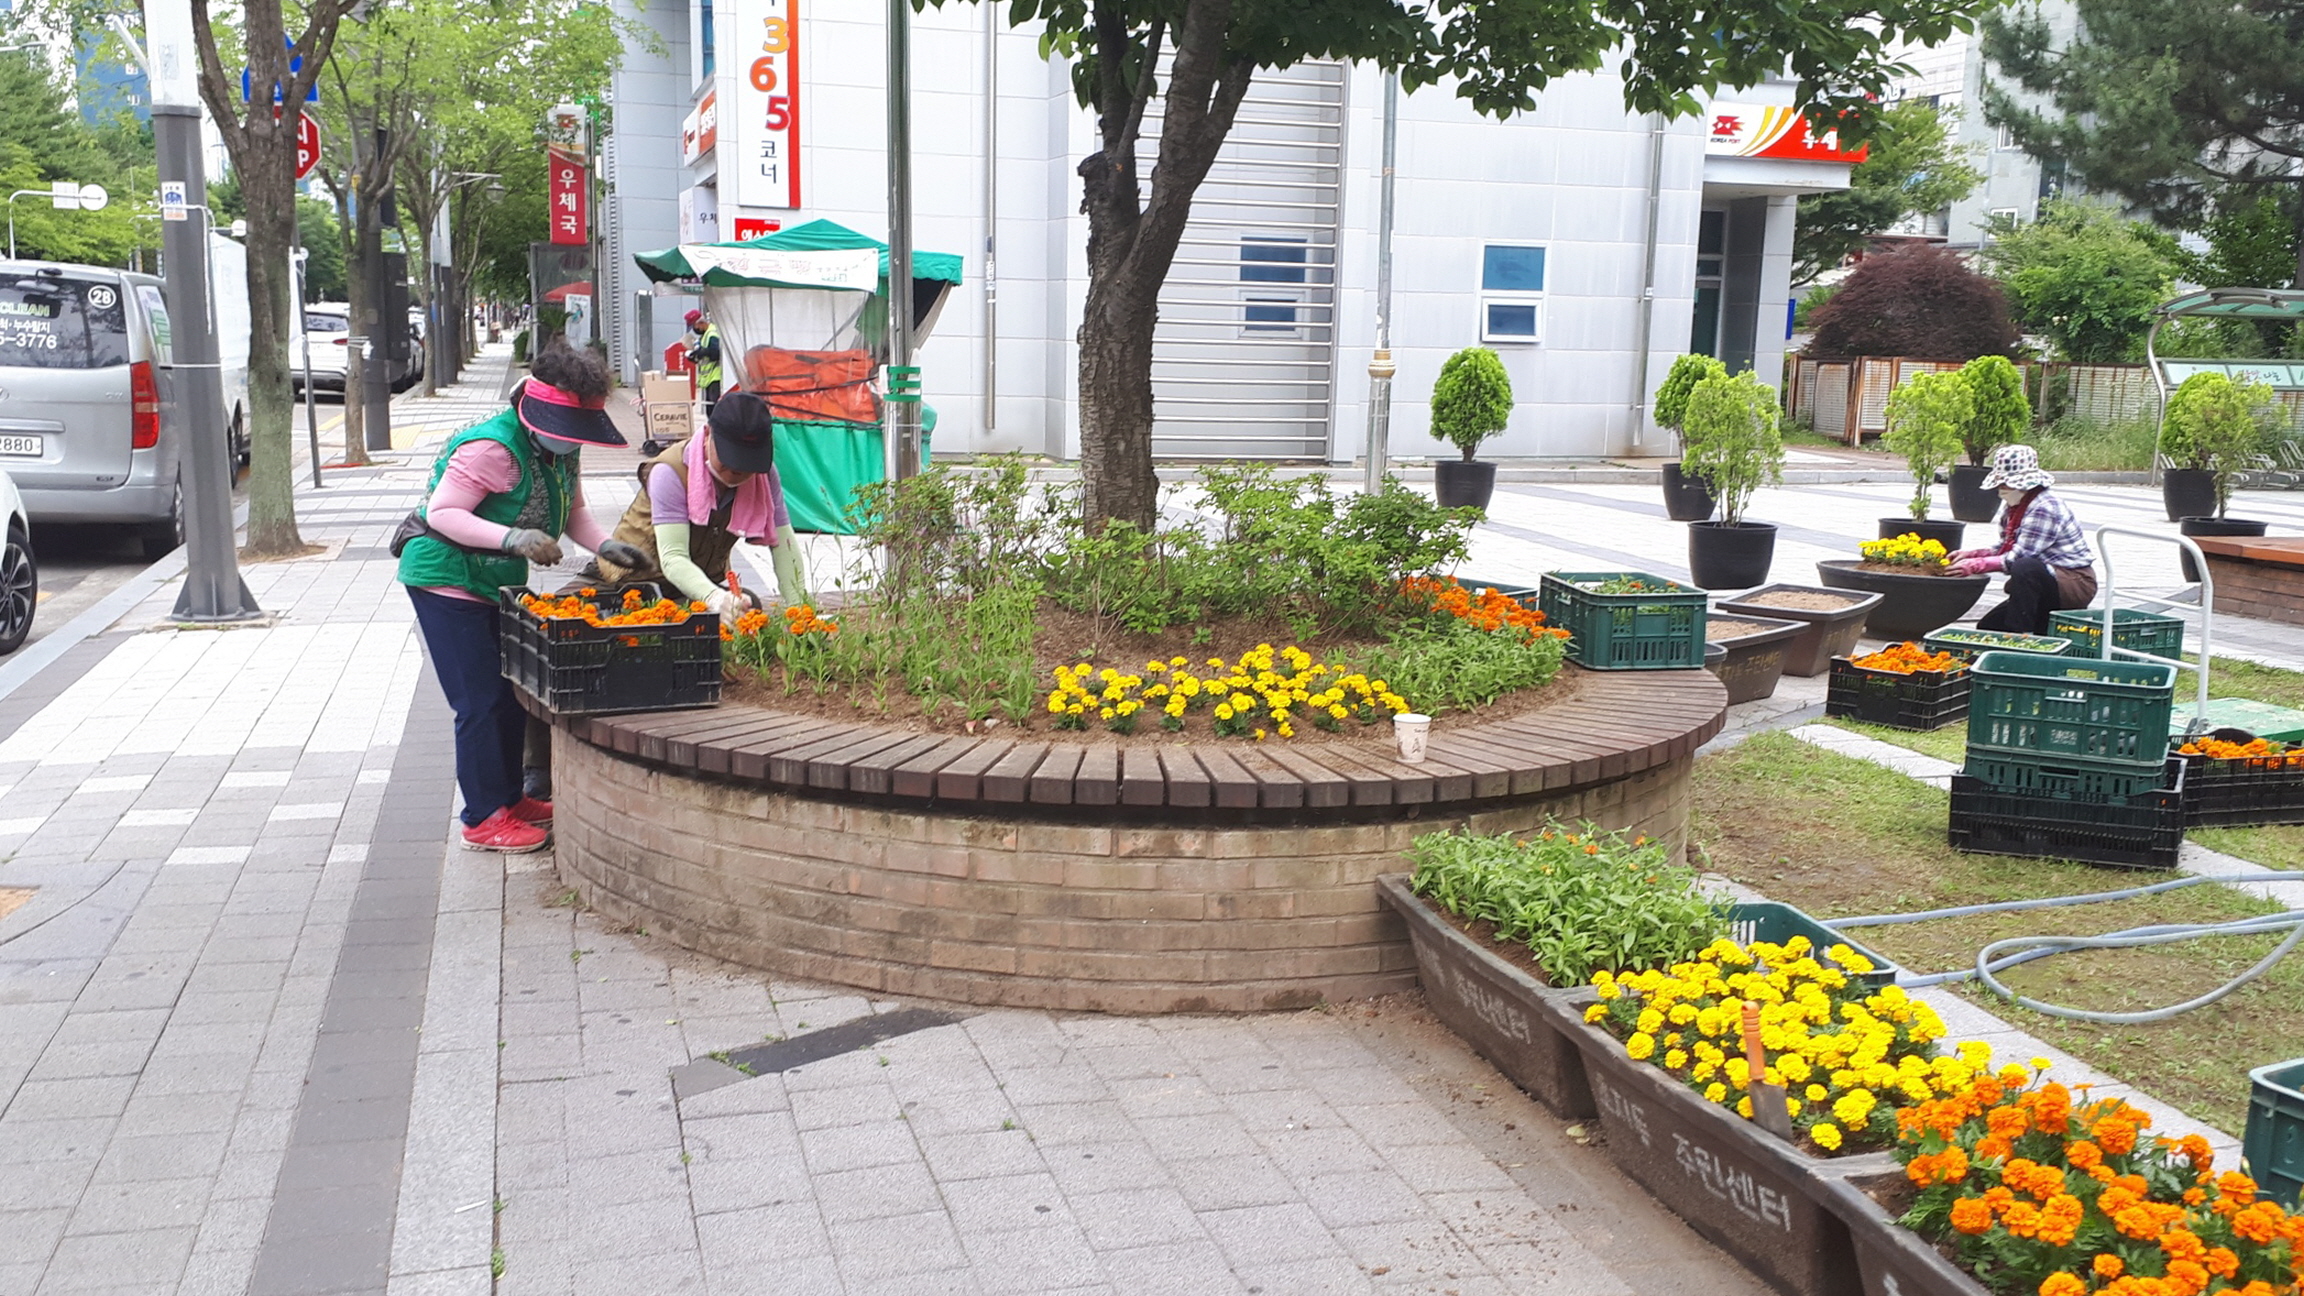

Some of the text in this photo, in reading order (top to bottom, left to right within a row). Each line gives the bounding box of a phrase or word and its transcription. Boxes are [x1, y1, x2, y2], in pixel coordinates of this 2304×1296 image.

[760, 140, 777, 184] 코너
[558, 168, 578, 235] 우체국
[92, 290, 111, 305] 28
[1672, 1132, 1792, 1233] 주민센터
